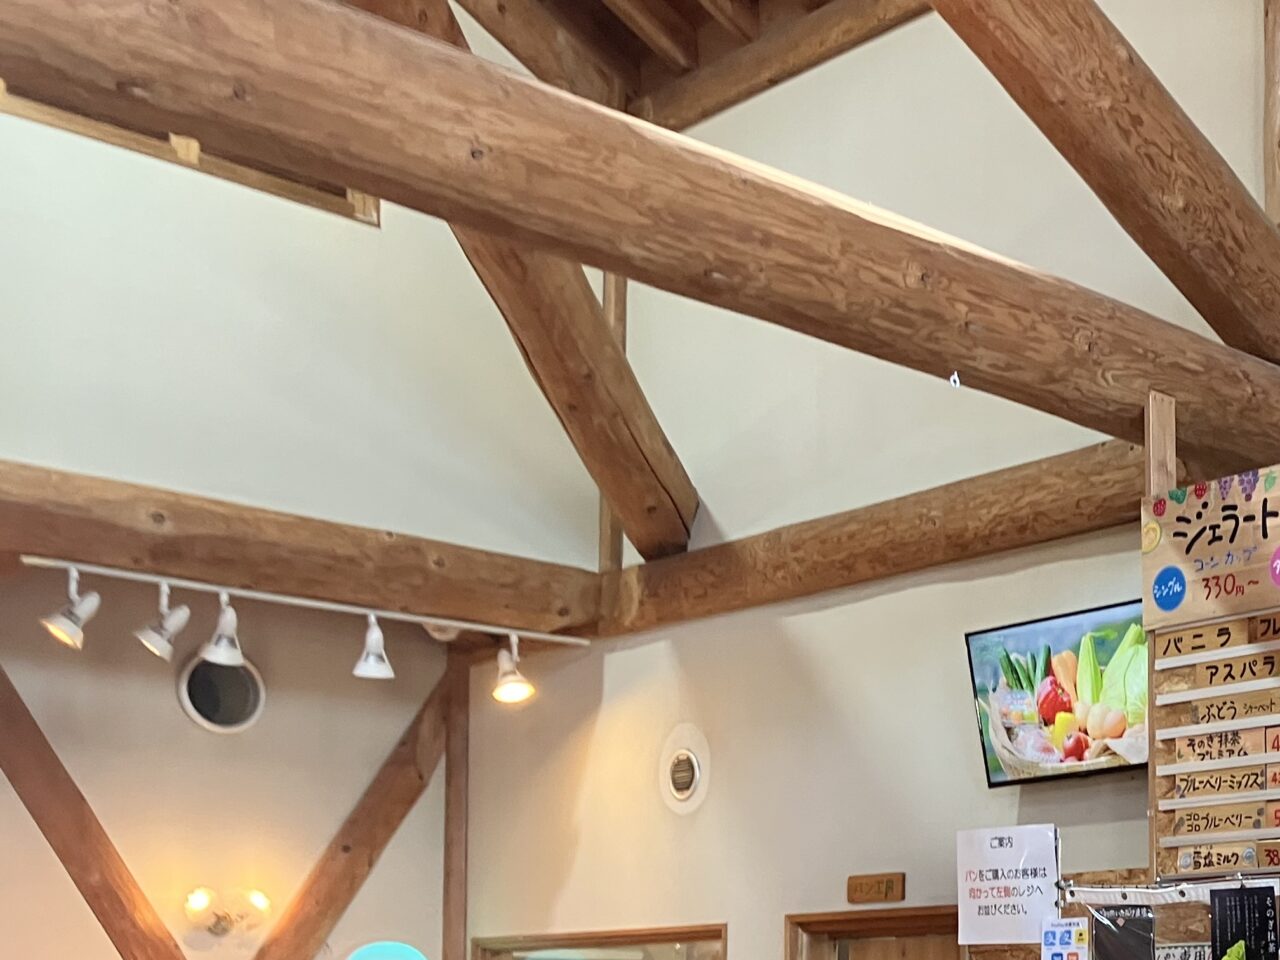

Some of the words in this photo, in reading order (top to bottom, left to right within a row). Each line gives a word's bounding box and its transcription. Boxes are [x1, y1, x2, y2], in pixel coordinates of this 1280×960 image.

[1173, 498, 1278, 554] ジェラート
[1224, 546, 1257, 566] カップ
[1153, 579, 1184, 599] シングル
[1163, 627, 1232, 656] バニラ
[1206, 656, 1275, 684] アスパラ
[1201, 702, 1237, 723] ぶどう
[1243, 700, 1276, 715] シャーベット
[1187, 731, 1241, 752] そのぎ抹茶
[1197, 748, 1248, 761] プレミアム
[1179, 772, 1263, 796] ブルーベリーミックス
[990, 836, 1013, 849] ご案内
[965, 867, 1047, 883] パンをご購入のお客様は
